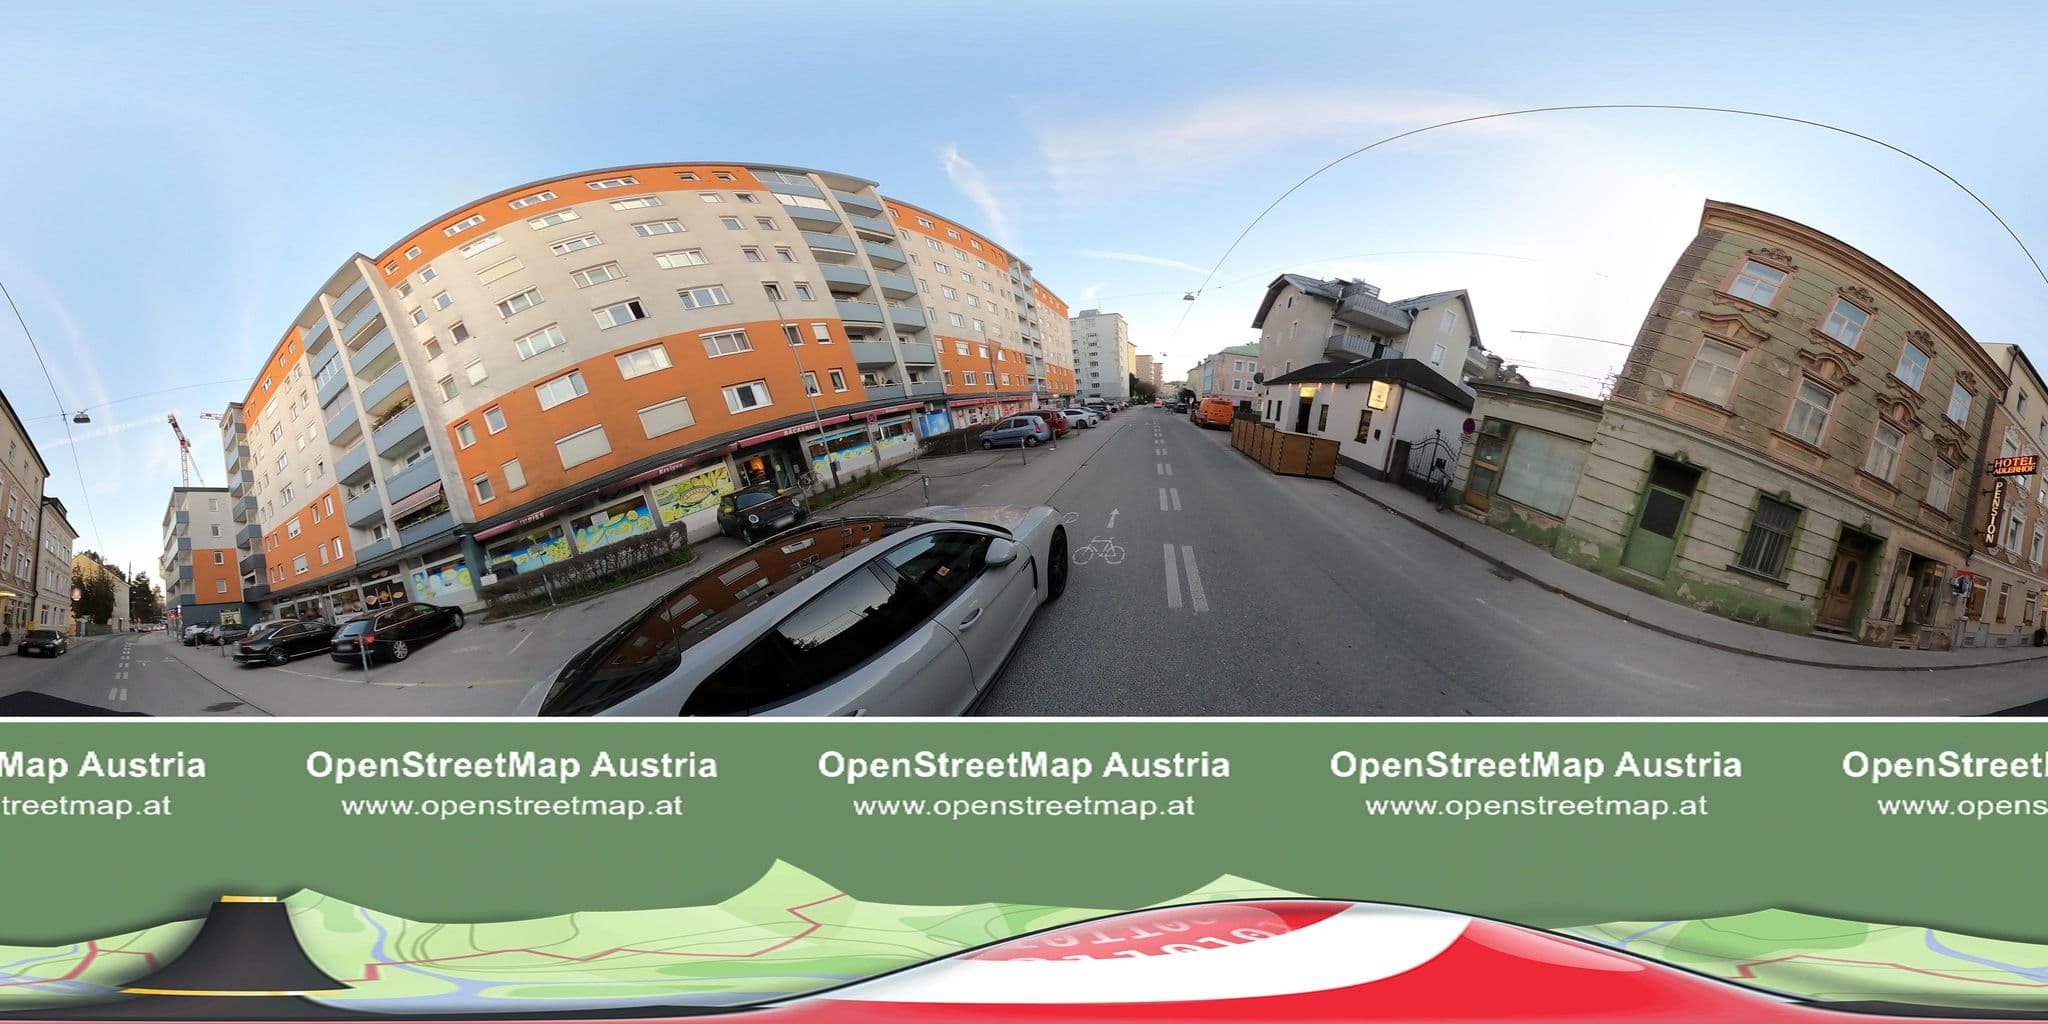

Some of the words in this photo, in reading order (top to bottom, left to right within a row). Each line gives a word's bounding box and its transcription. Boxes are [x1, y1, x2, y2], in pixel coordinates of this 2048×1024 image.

[1994, 457, 2036, 468] HOTEL
[1993, 465, 2035, 475] ADLERHOF
[1985, 481, 2004, 544] PENSION
